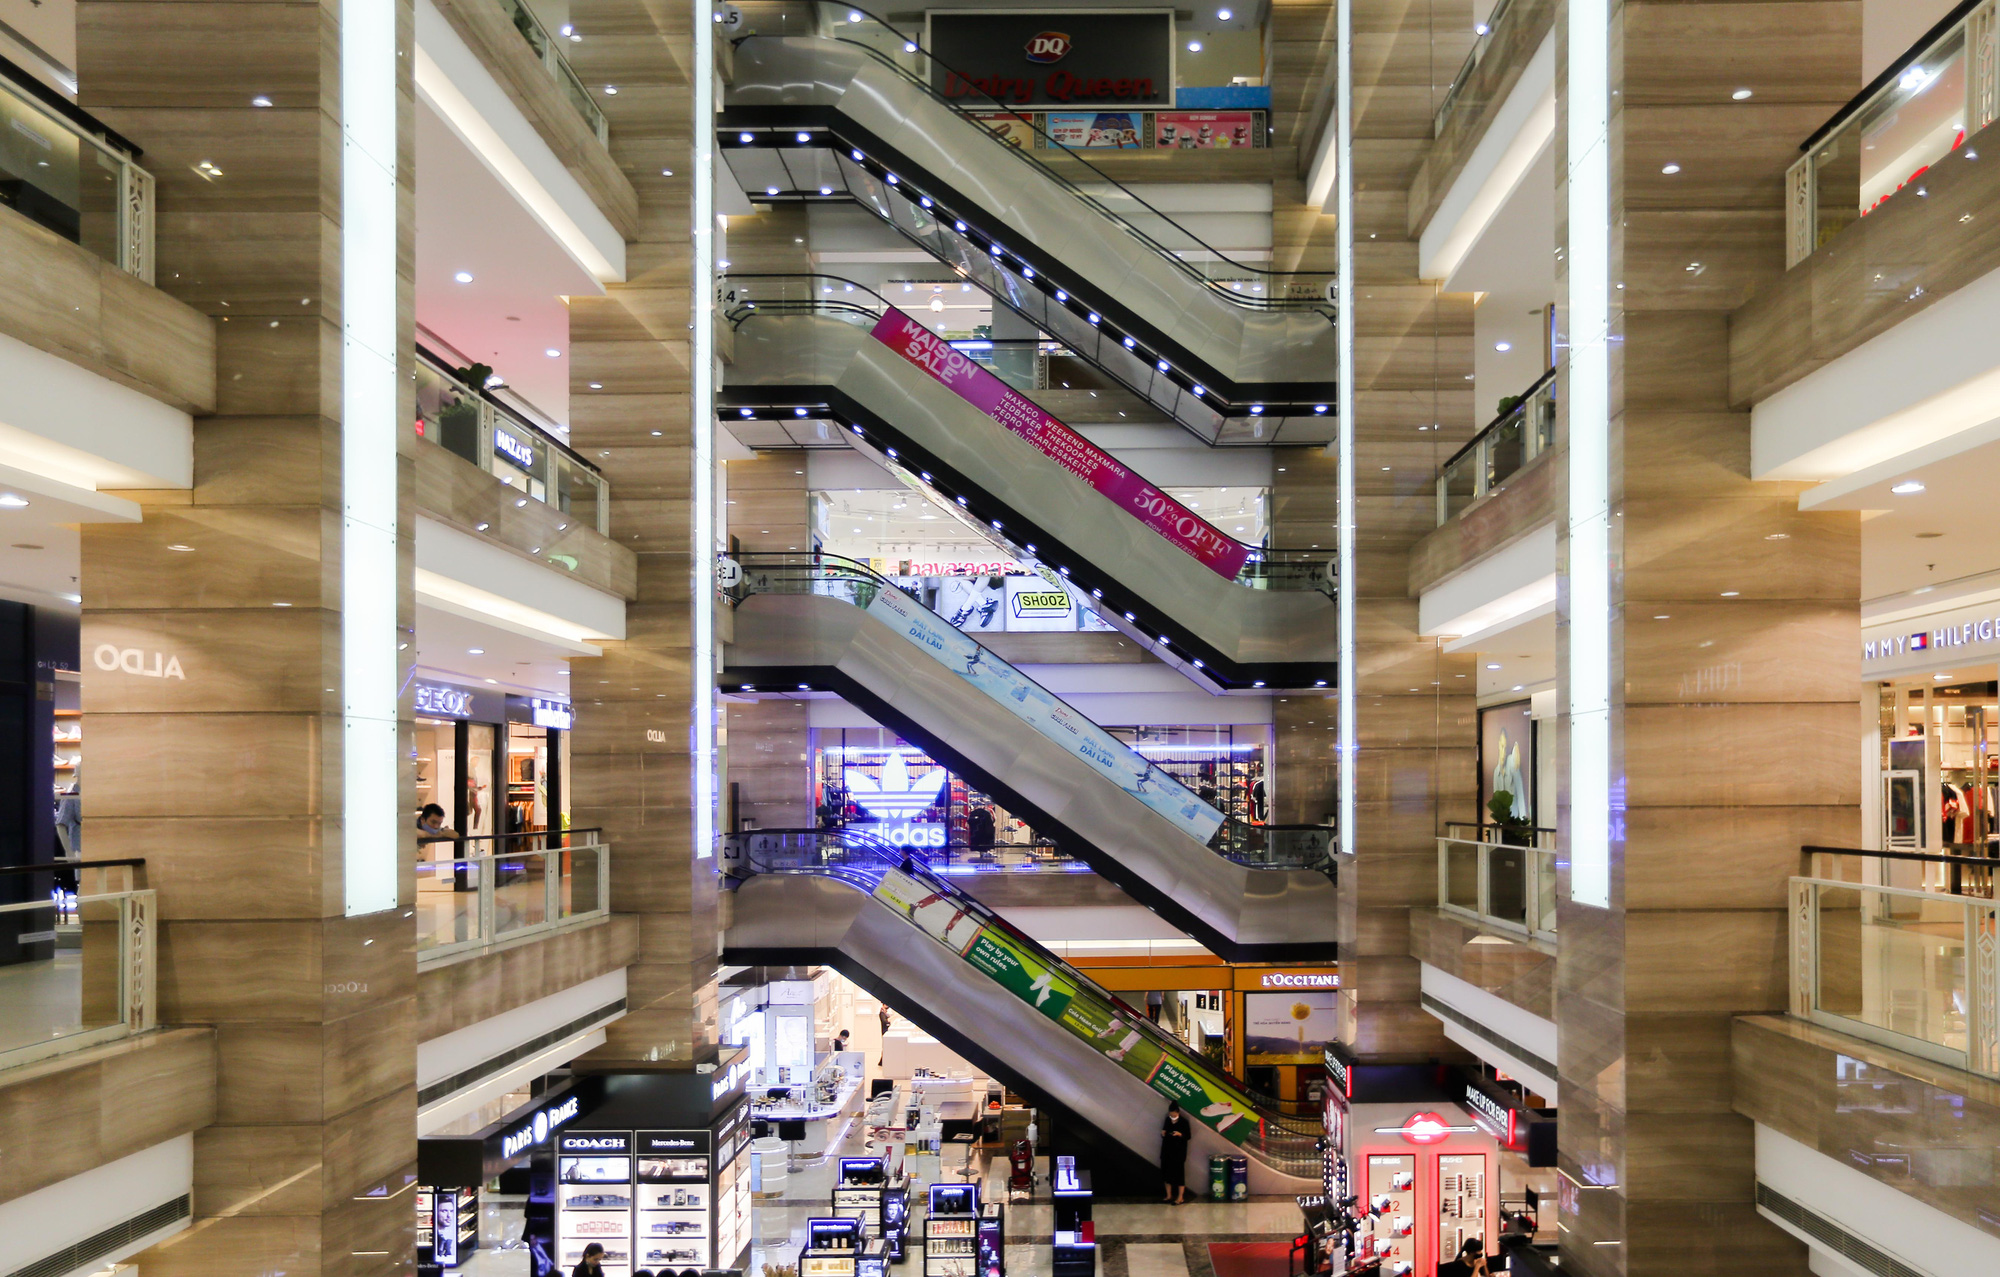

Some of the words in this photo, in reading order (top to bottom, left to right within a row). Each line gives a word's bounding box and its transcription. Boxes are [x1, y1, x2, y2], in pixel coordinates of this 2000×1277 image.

[1034, 38, 1064, 56] DQ
[944, 69, 1034, 105] Dairy
[902, 320, 979, 380] MAISON
[905, 341, 953, 384] SALE
[1004, 391, 1040, 420] MAX&CO.
[994, 405, 1022, 428] PEDRO
[1026, 427, 1092, 476] CHARLES&KEITH
[1000, 398, 1042, 431] TEDBAKER
[1046, 430, 1099, 470] THEKOOPLES
[1044, 419, 1085, 450] WEEKEND
[1085, 447, 1126, 479] MAXMARA
[1144, 519, 1162, 535] FROM
[1162, 532, 1200, 559] 01/07/2021
[1022, 595, 1066, 606] SHOOZ
[975, 946, 990, 959] own
[990, 956, 1008, 971] rules.
[980, 938, 995, 952] Play
[994, 947, 1003, 958] by
[1002, 953, 1019, 967] your
[1068, 1008, 1079, 1018] Cole
[1079, 1015, 1092, 1027] Haan
[1159, 1072, 1174, 1085] own
[1173, 1082, 1192, 1097] rules.
[1163, 1064, 1179, 1078] Play
[1178, 1073, 1188, 1083] by
[1186, 1080, 1202, 1093] your
[1466, 1085, 1479, 1106] MAKE
[1479, 1093, 1486, 1109] UP
[1486, 1098, 1496, 1118] FOR
[1495, 1105, 1508, 1127] EVER
[503, 1125, 533, 1159] PARIS
[549, 1097, 579, 1129] FRANCE
[564, 1138, 625, 1148] COACH
[651, 1139, 695, 1147] Mercedes-Benz
[1392, 1201, 1400, 1211] 2
[1392, 1246, 1400, 1256] 4
